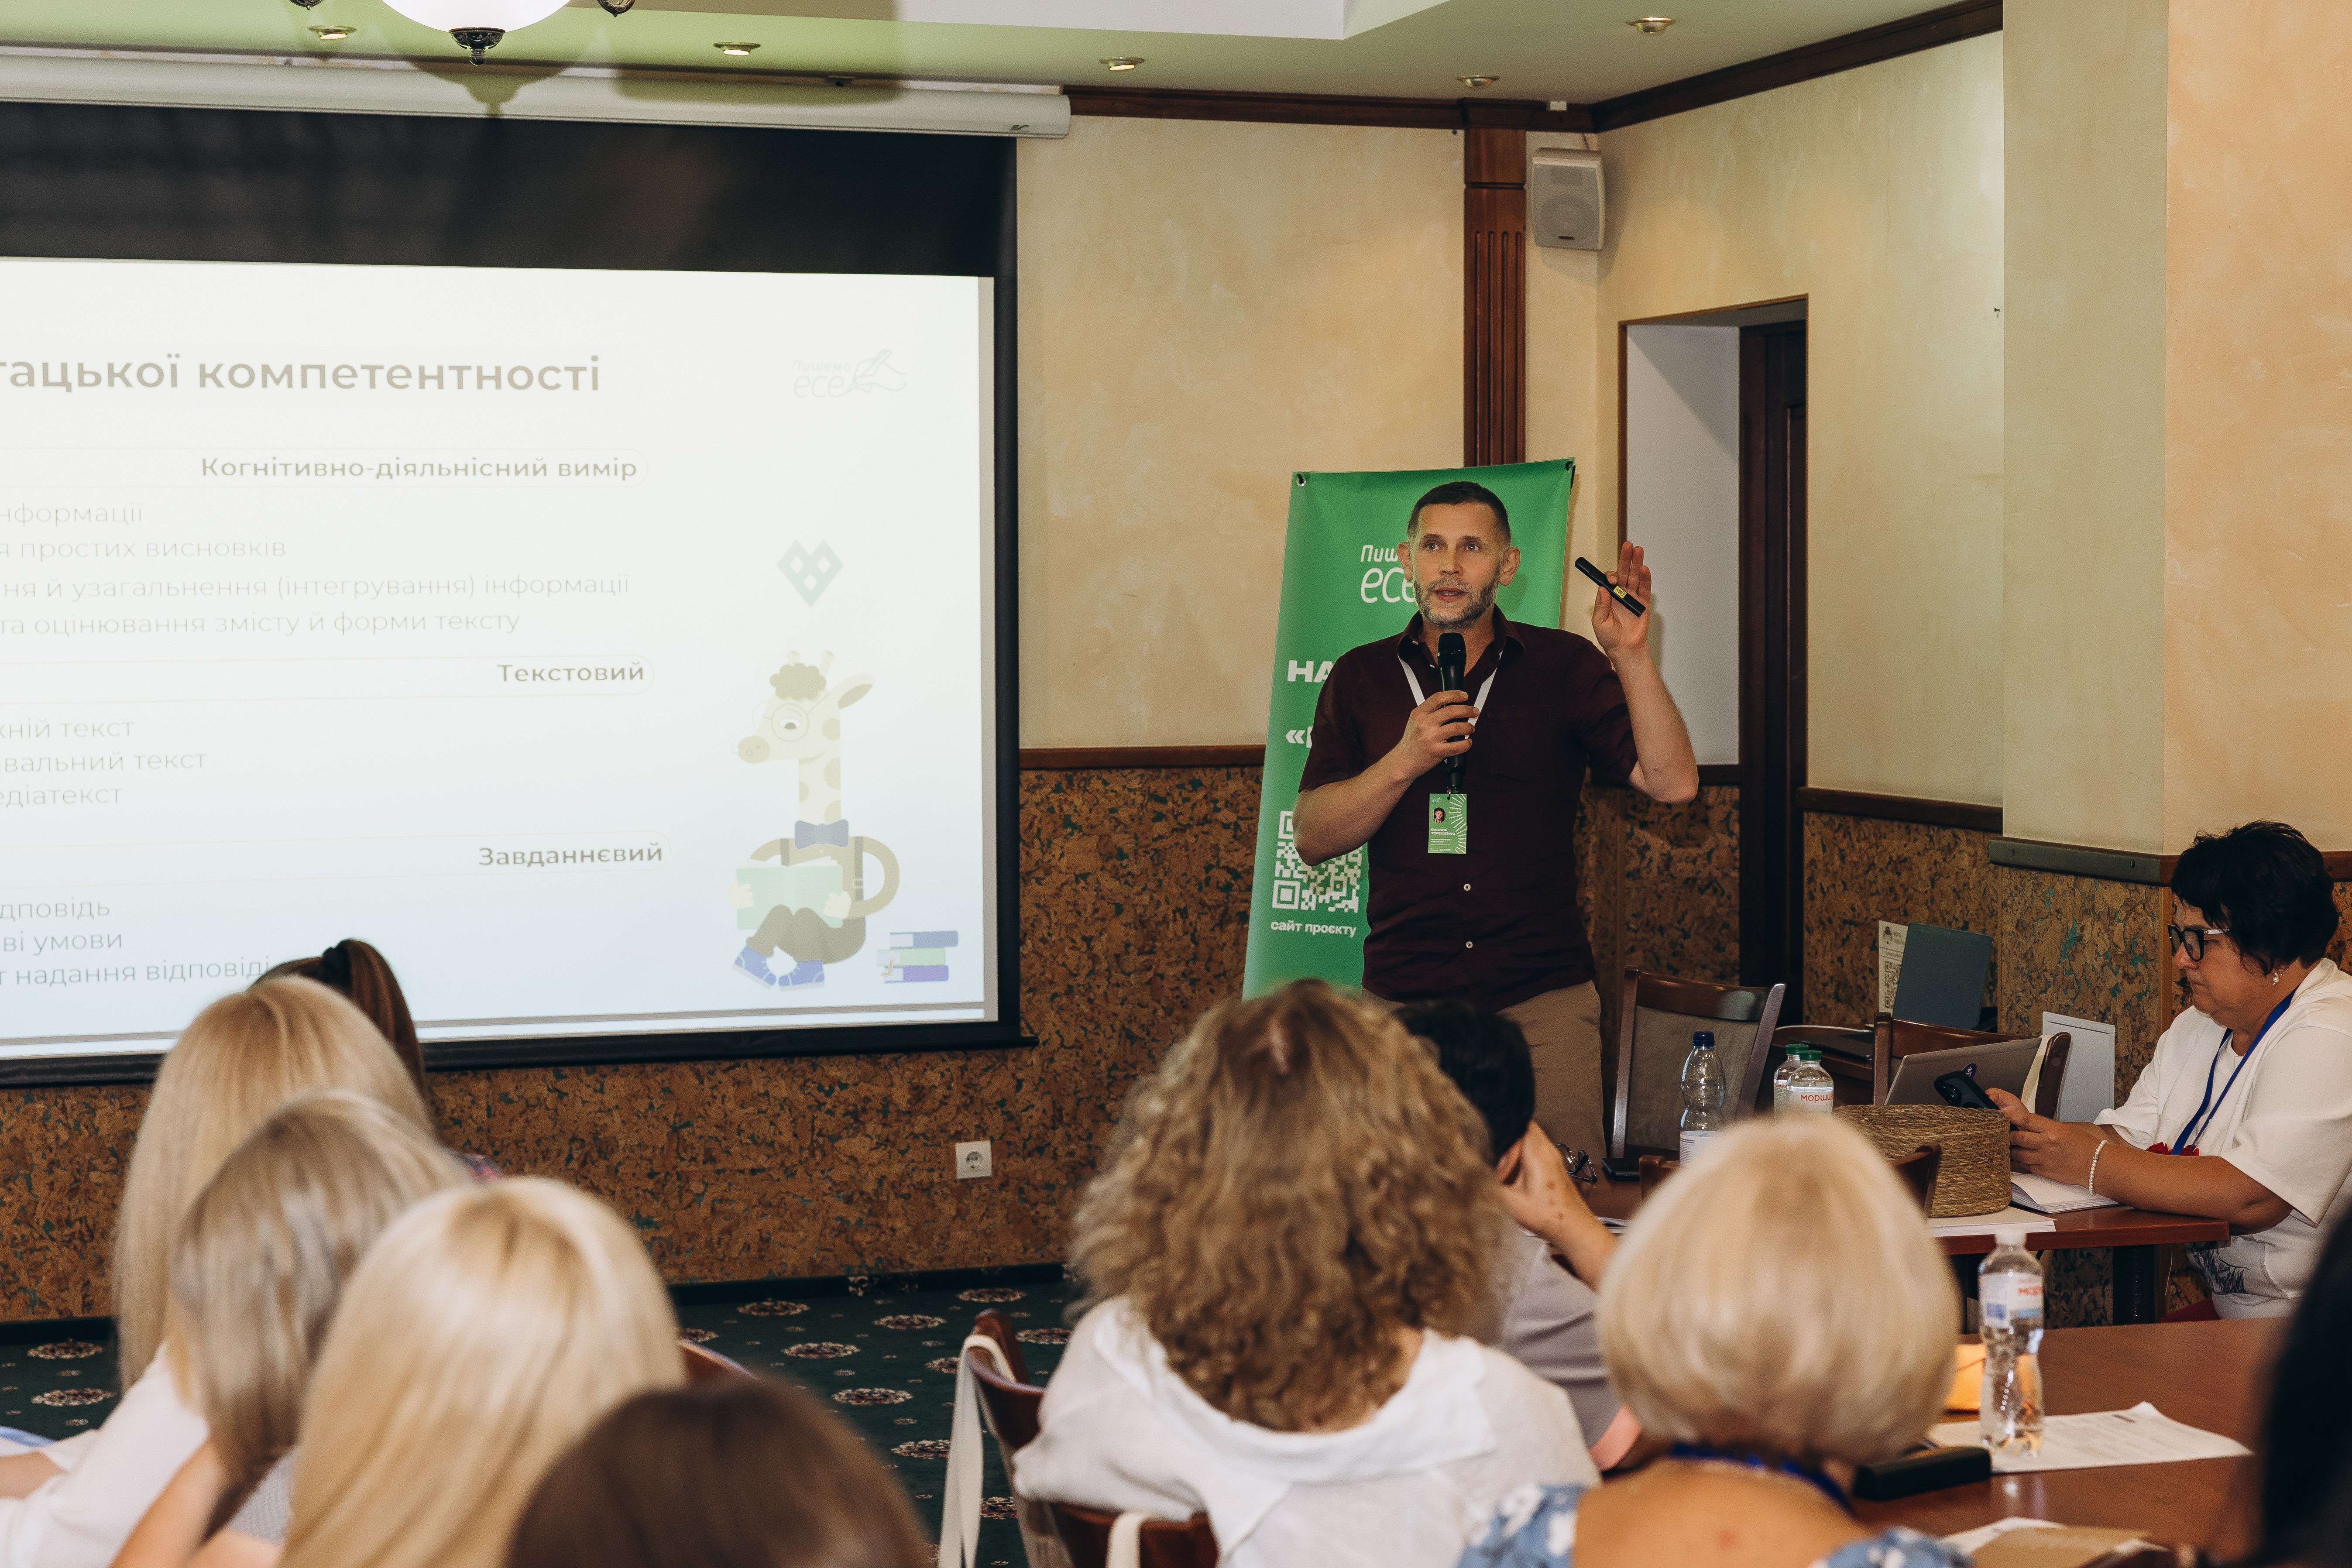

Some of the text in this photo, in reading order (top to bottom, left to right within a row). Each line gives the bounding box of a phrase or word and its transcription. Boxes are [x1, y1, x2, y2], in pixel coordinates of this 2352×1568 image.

[0, 353, 599, 393] ацької компетентності
[793, 374, 845, 399] есе
[202, 456, 637, 482] Когнітивно-діяльнісний вимір
[20, 542, 136, 563] простих
[146, 536, 286, 557] висновків
[47, 577, 62, 597] й
[72, 581, 267, 603] узагальнення
[278, 575, 475, 600] (інтегрування)
[485, 574, 628, 598] інформації
[34, 613, 205, 638] оцінювання
[216, 611, 300, 637] змісту
[309, 611, 324, 631] й
[333, 611, 426, 636] форми
[436, 614, 520, 635] тексту
[497, 662, 644, 682] Текстовий
[60, 721, 134, 738] текст
[134, 753, 208, 770] текст
[479, 842, 662, 868] Завданнєвий
[1270, 920, 1357, 938] сайт проєкту
[33, 933, 122, 957] умови
[16, 966, 136, 987] надання
